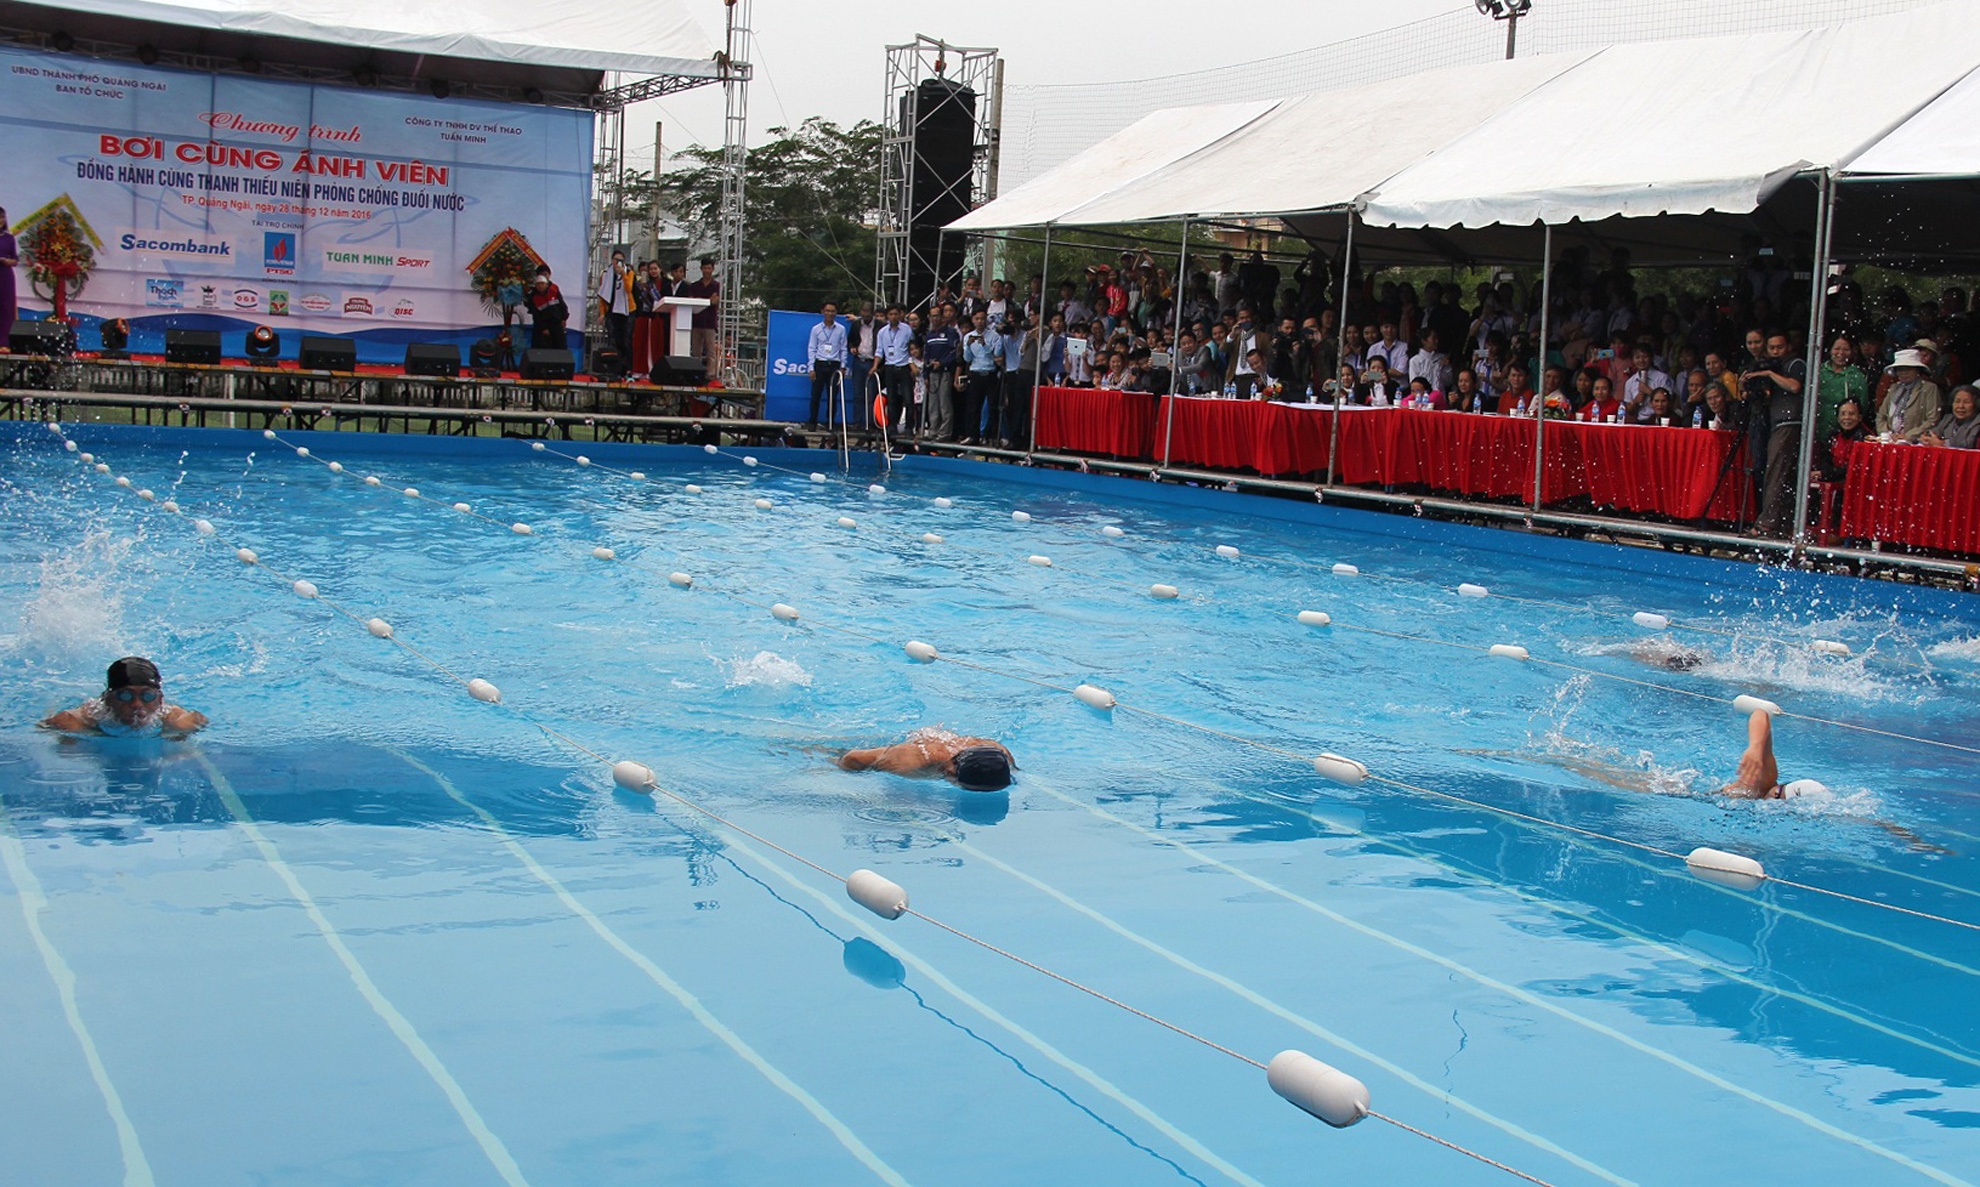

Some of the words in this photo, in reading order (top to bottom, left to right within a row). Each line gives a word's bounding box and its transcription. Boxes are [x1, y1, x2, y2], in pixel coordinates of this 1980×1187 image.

[11, 66, 39, 76] UBND
[56, 84, 76, 94] BAN
[199, 112, 299, 142] Chương
[309, 124, 362, 142] trình
[445, 121, 467, 129] TNHH
[469, 123, 481, 131] DV
[100, 134, 164, 161] BƠI
[175, 140, 283, 171] CÙNG
[292, 149, 365, 179] ÁNH
[375, 159, 449, 187] VIÊN
[118, 164, 154, 185] HÀNH
[158, 167, 194, 188] CÙNG
[198, 174, 239, 192] THANH
[243, 174, 277, 196] THIẾU
[281, 179, 310, 199] NIÊN
[314, 182, 354, 203] PHÒNG
[358, 184, 398, 206] CHỐNG
[402, 188, 429, 209] ĐUỐI
[433, 192, 465, 211] NƯỚC
[280, 203, 289, 213] 28
[319, 207, 329, 216] 12
[352, 210, 371, 219] 2016
[121, 234, 230, 255] Sacombank
[326, 252, 359, 263] TUAN
[363, 254, 393, 266] MINH
[396, 256, 431, 268] SPORT
